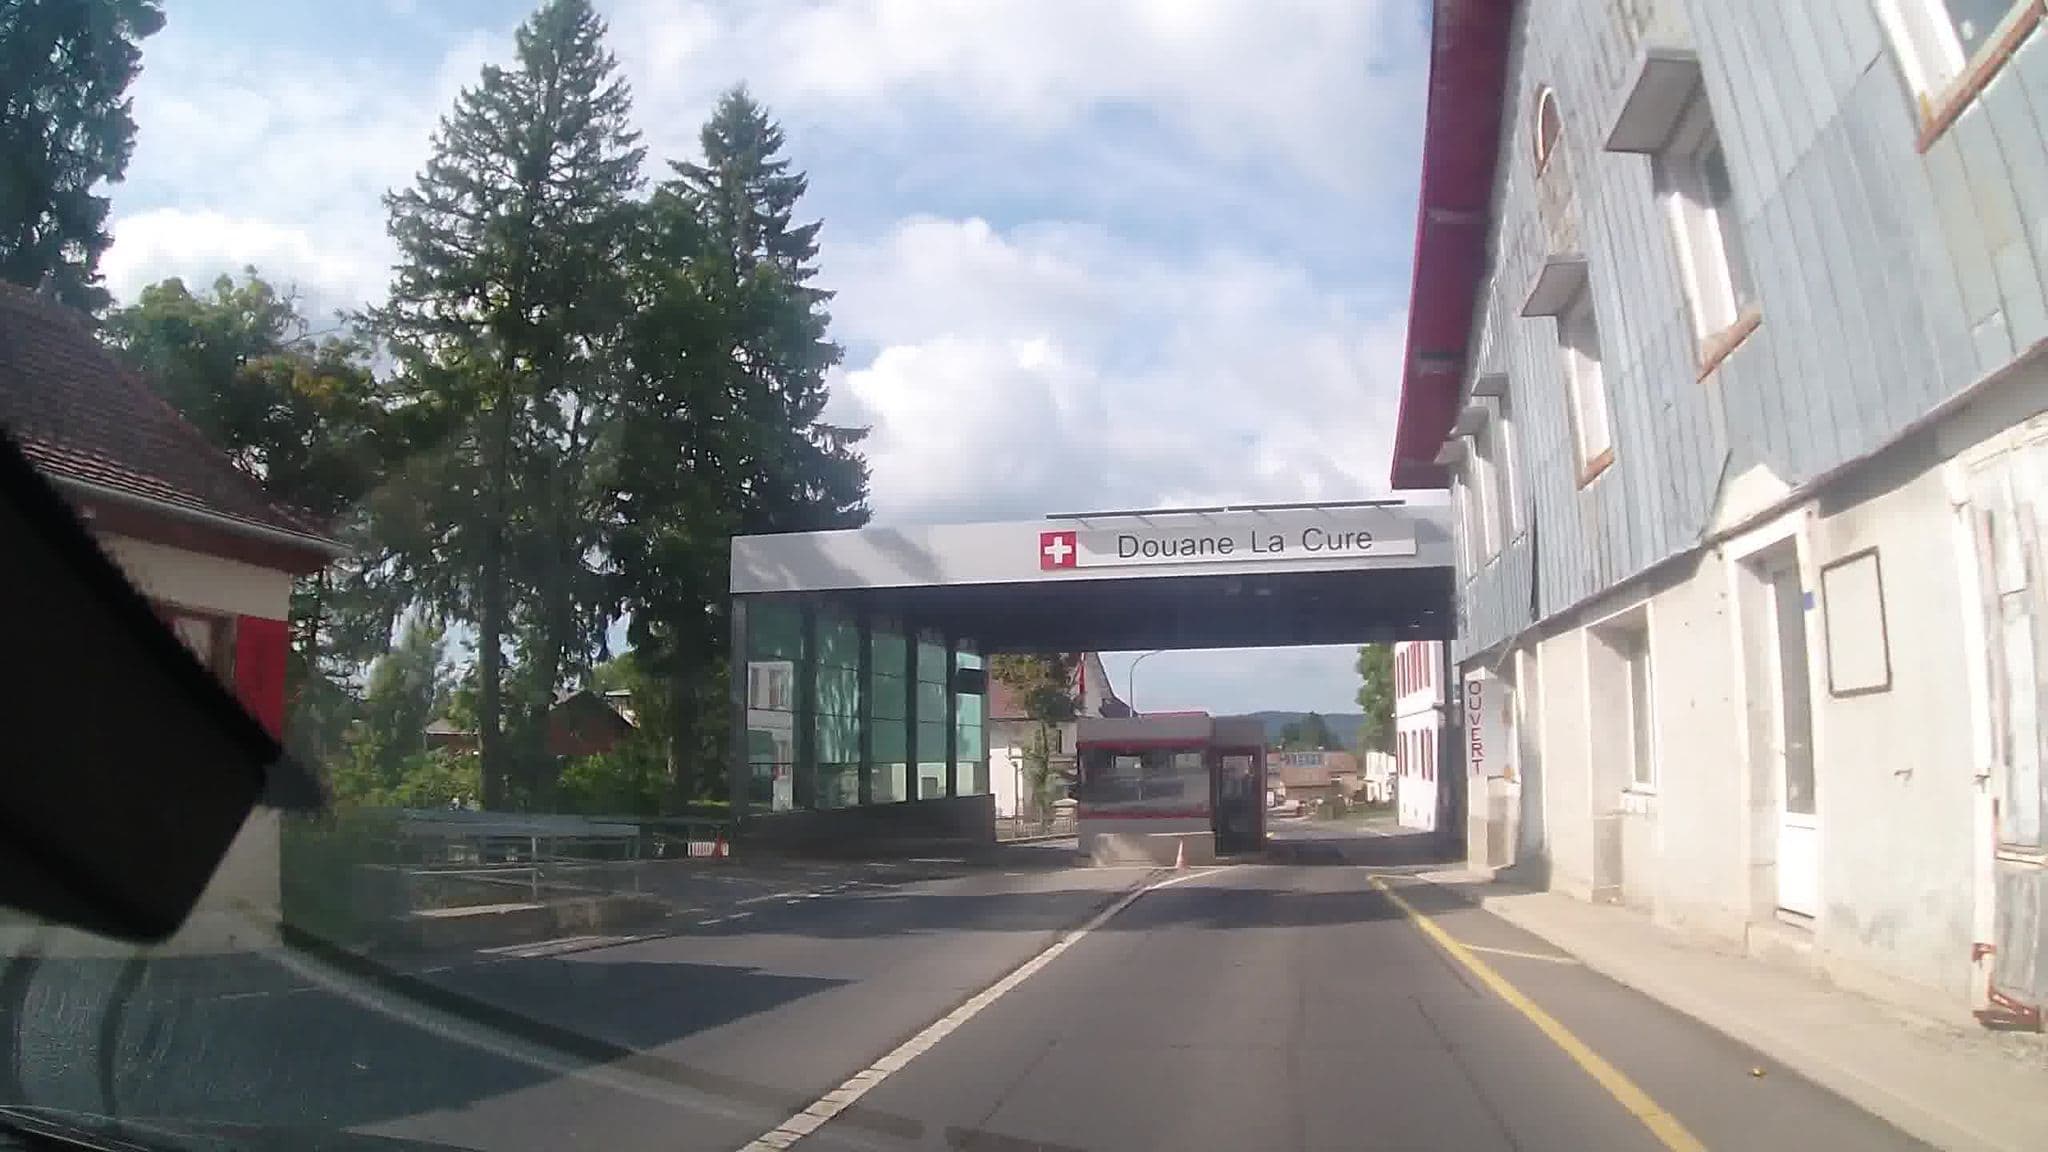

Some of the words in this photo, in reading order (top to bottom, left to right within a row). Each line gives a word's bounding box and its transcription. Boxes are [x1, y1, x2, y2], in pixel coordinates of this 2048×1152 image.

[1118, 533, 1234, 559] Douane
[1251, 530, 1284, 554] La
[1302, 527, 1373, 552] Cure
[1468, 681, 1485, 775] OUVERT
